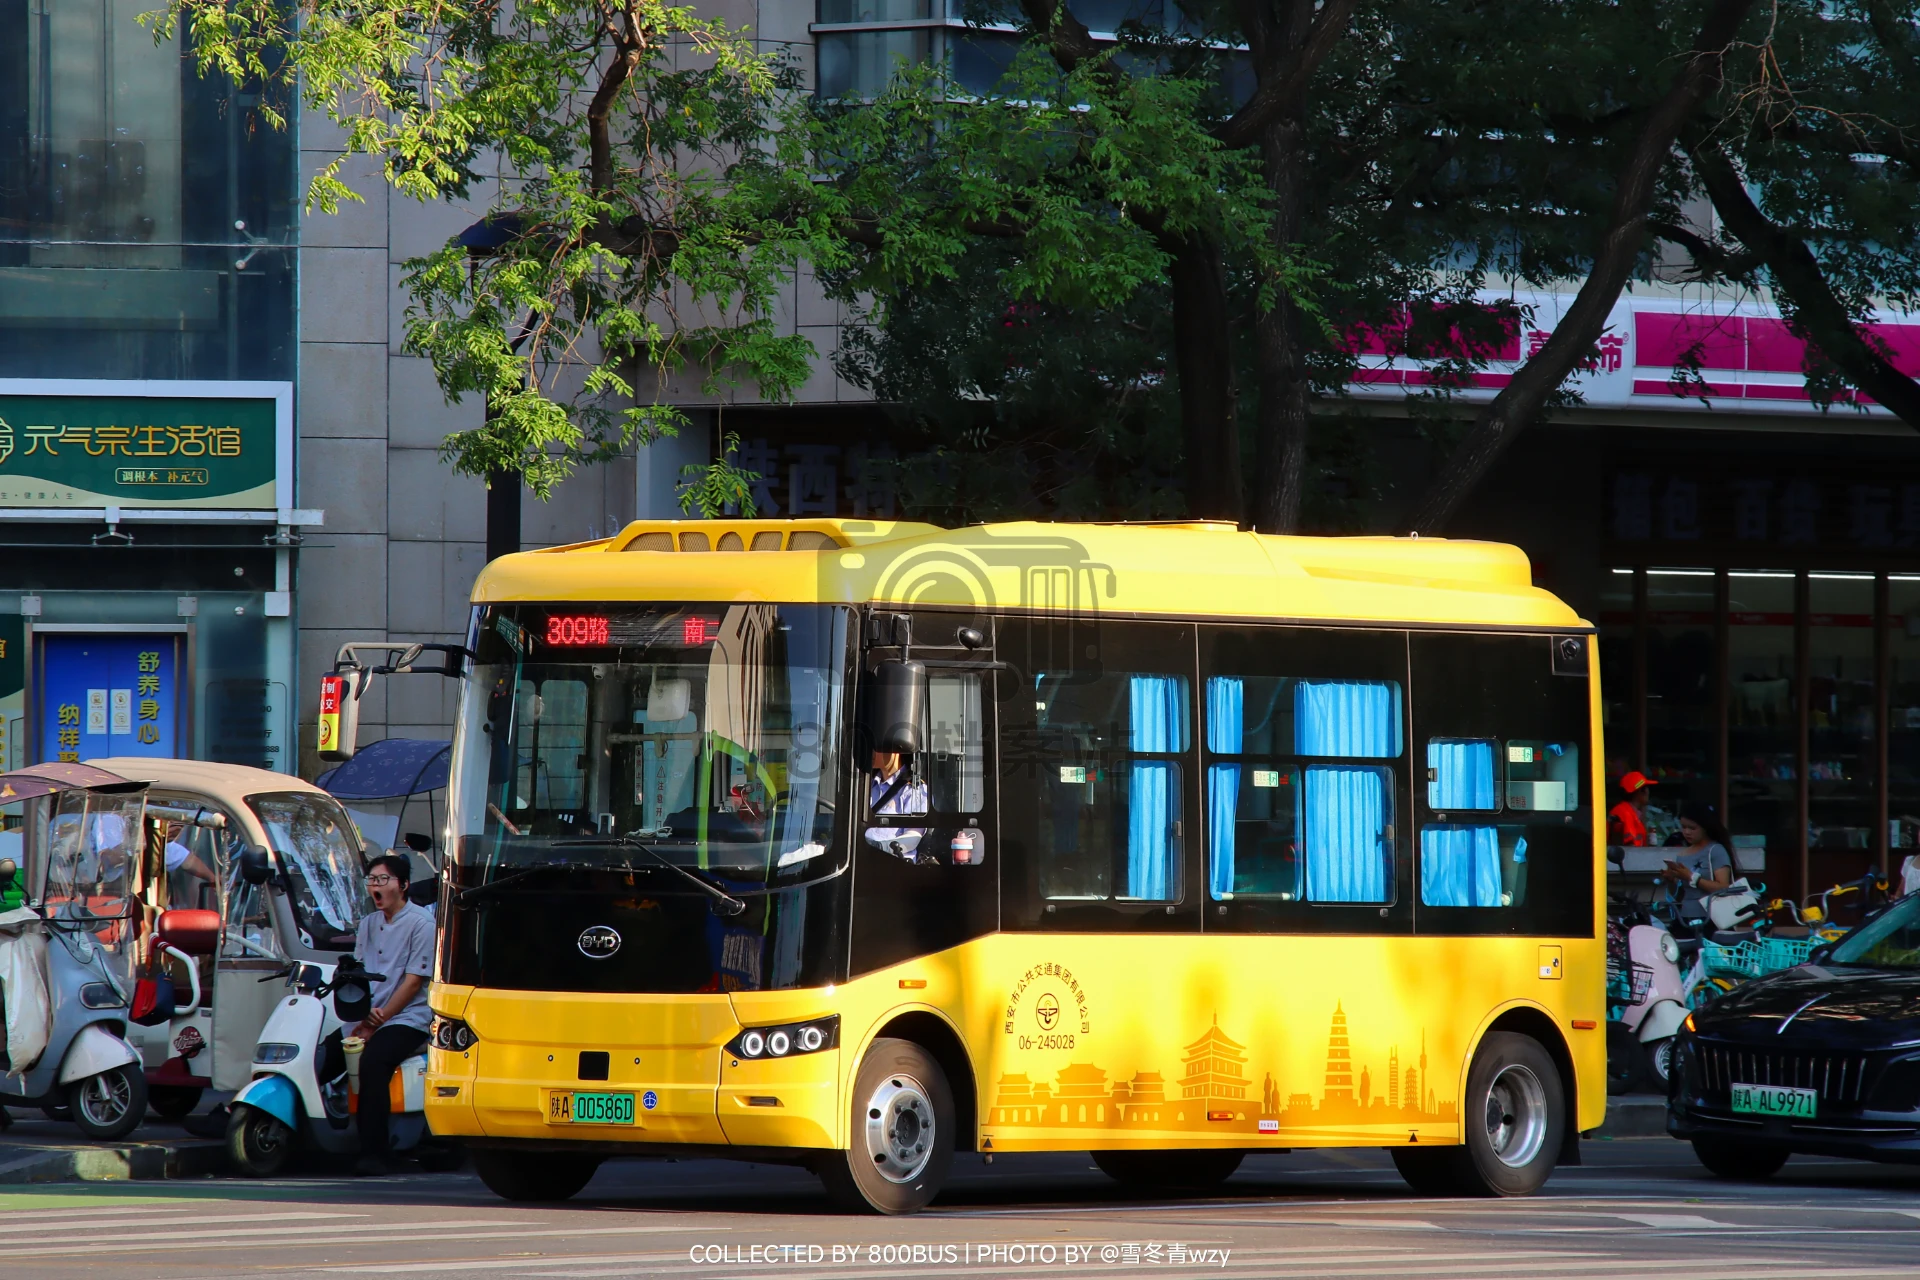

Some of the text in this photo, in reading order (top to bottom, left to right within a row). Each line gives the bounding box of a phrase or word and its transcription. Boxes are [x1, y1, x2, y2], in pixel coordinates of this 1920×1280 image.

[23, 424, 241, 457] 元气宗生活馆
[122, 470, 204, 483] 调根本 补元气
[547, 616, 609, 645] 309路
[138, 651, 160, 744] 舒养身心
[582, 935, 616, 948] BYD
[1004, 962, 1090, 1035] 西安市公共交通集团有限公司
[1018, 1034, 1075, 1050] 06-245028
[577, 1097, 633, 1121] 00586D
[1759, 1090, 1813, 1115] AL9971
